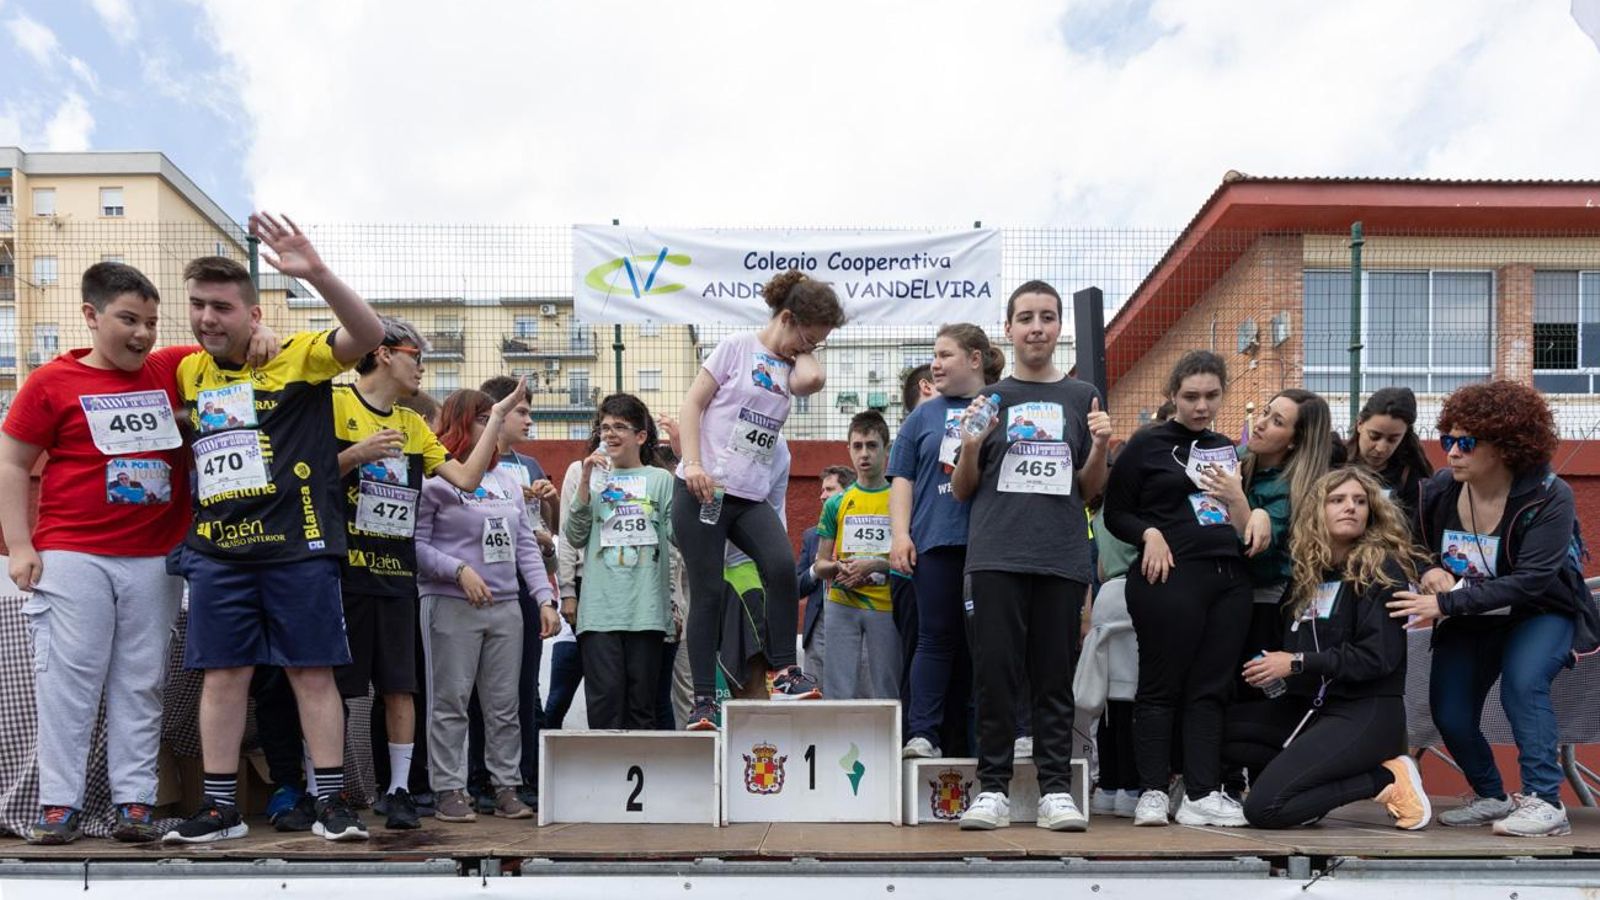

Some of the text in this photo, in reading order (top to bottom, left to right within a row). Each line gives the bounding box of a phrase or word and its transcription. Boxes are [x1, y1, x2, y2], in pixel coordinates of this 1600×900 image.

[744, 250, 951, 276] Colegio Cooperativa
[702, 279, 992, 299] ANDR VANDELVIRA
[109, 412, 158, 433] 469
[745, 429, 775, 450] 466
[204, 453, 243, 476] 470
[1015, 460, 1057, 477] 465
[300, 485, 321, 540] Blanca
[373, 501, 409, 521] 472
[212, 517, 264, 543] Jaén
[612, 518, 647, 532] 458
[854, 528, 885, 541] 453
[366, 552, 402, 570] Jaén
[804, 744, 817, 790] 1
[626, 765, 644, 812] 2
